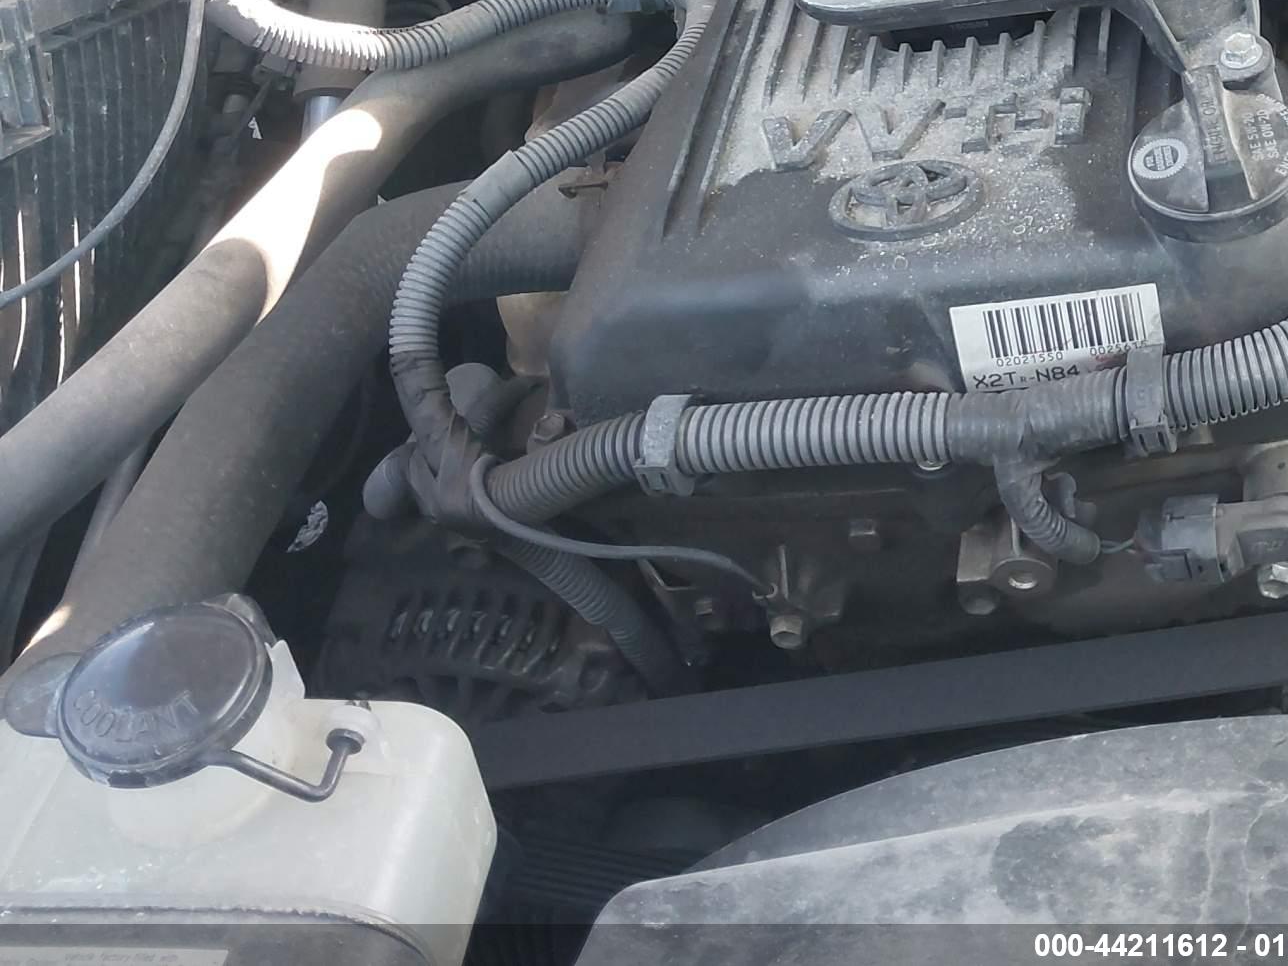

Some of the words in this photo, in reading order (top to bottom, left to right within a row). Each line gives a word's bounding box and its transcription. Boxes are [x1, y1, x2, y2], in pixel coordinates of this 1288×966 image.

[1246, 112, 1260, 141] 5W-20
[1261, 109, 1275, 138] 0W-20
[1251, 140, 1265, 162] SAE
[1266, 138, 1280, 160] SAE
[996, 352, 1064, 367] 02021550
[73, 688, 200, 743] COOLANT
